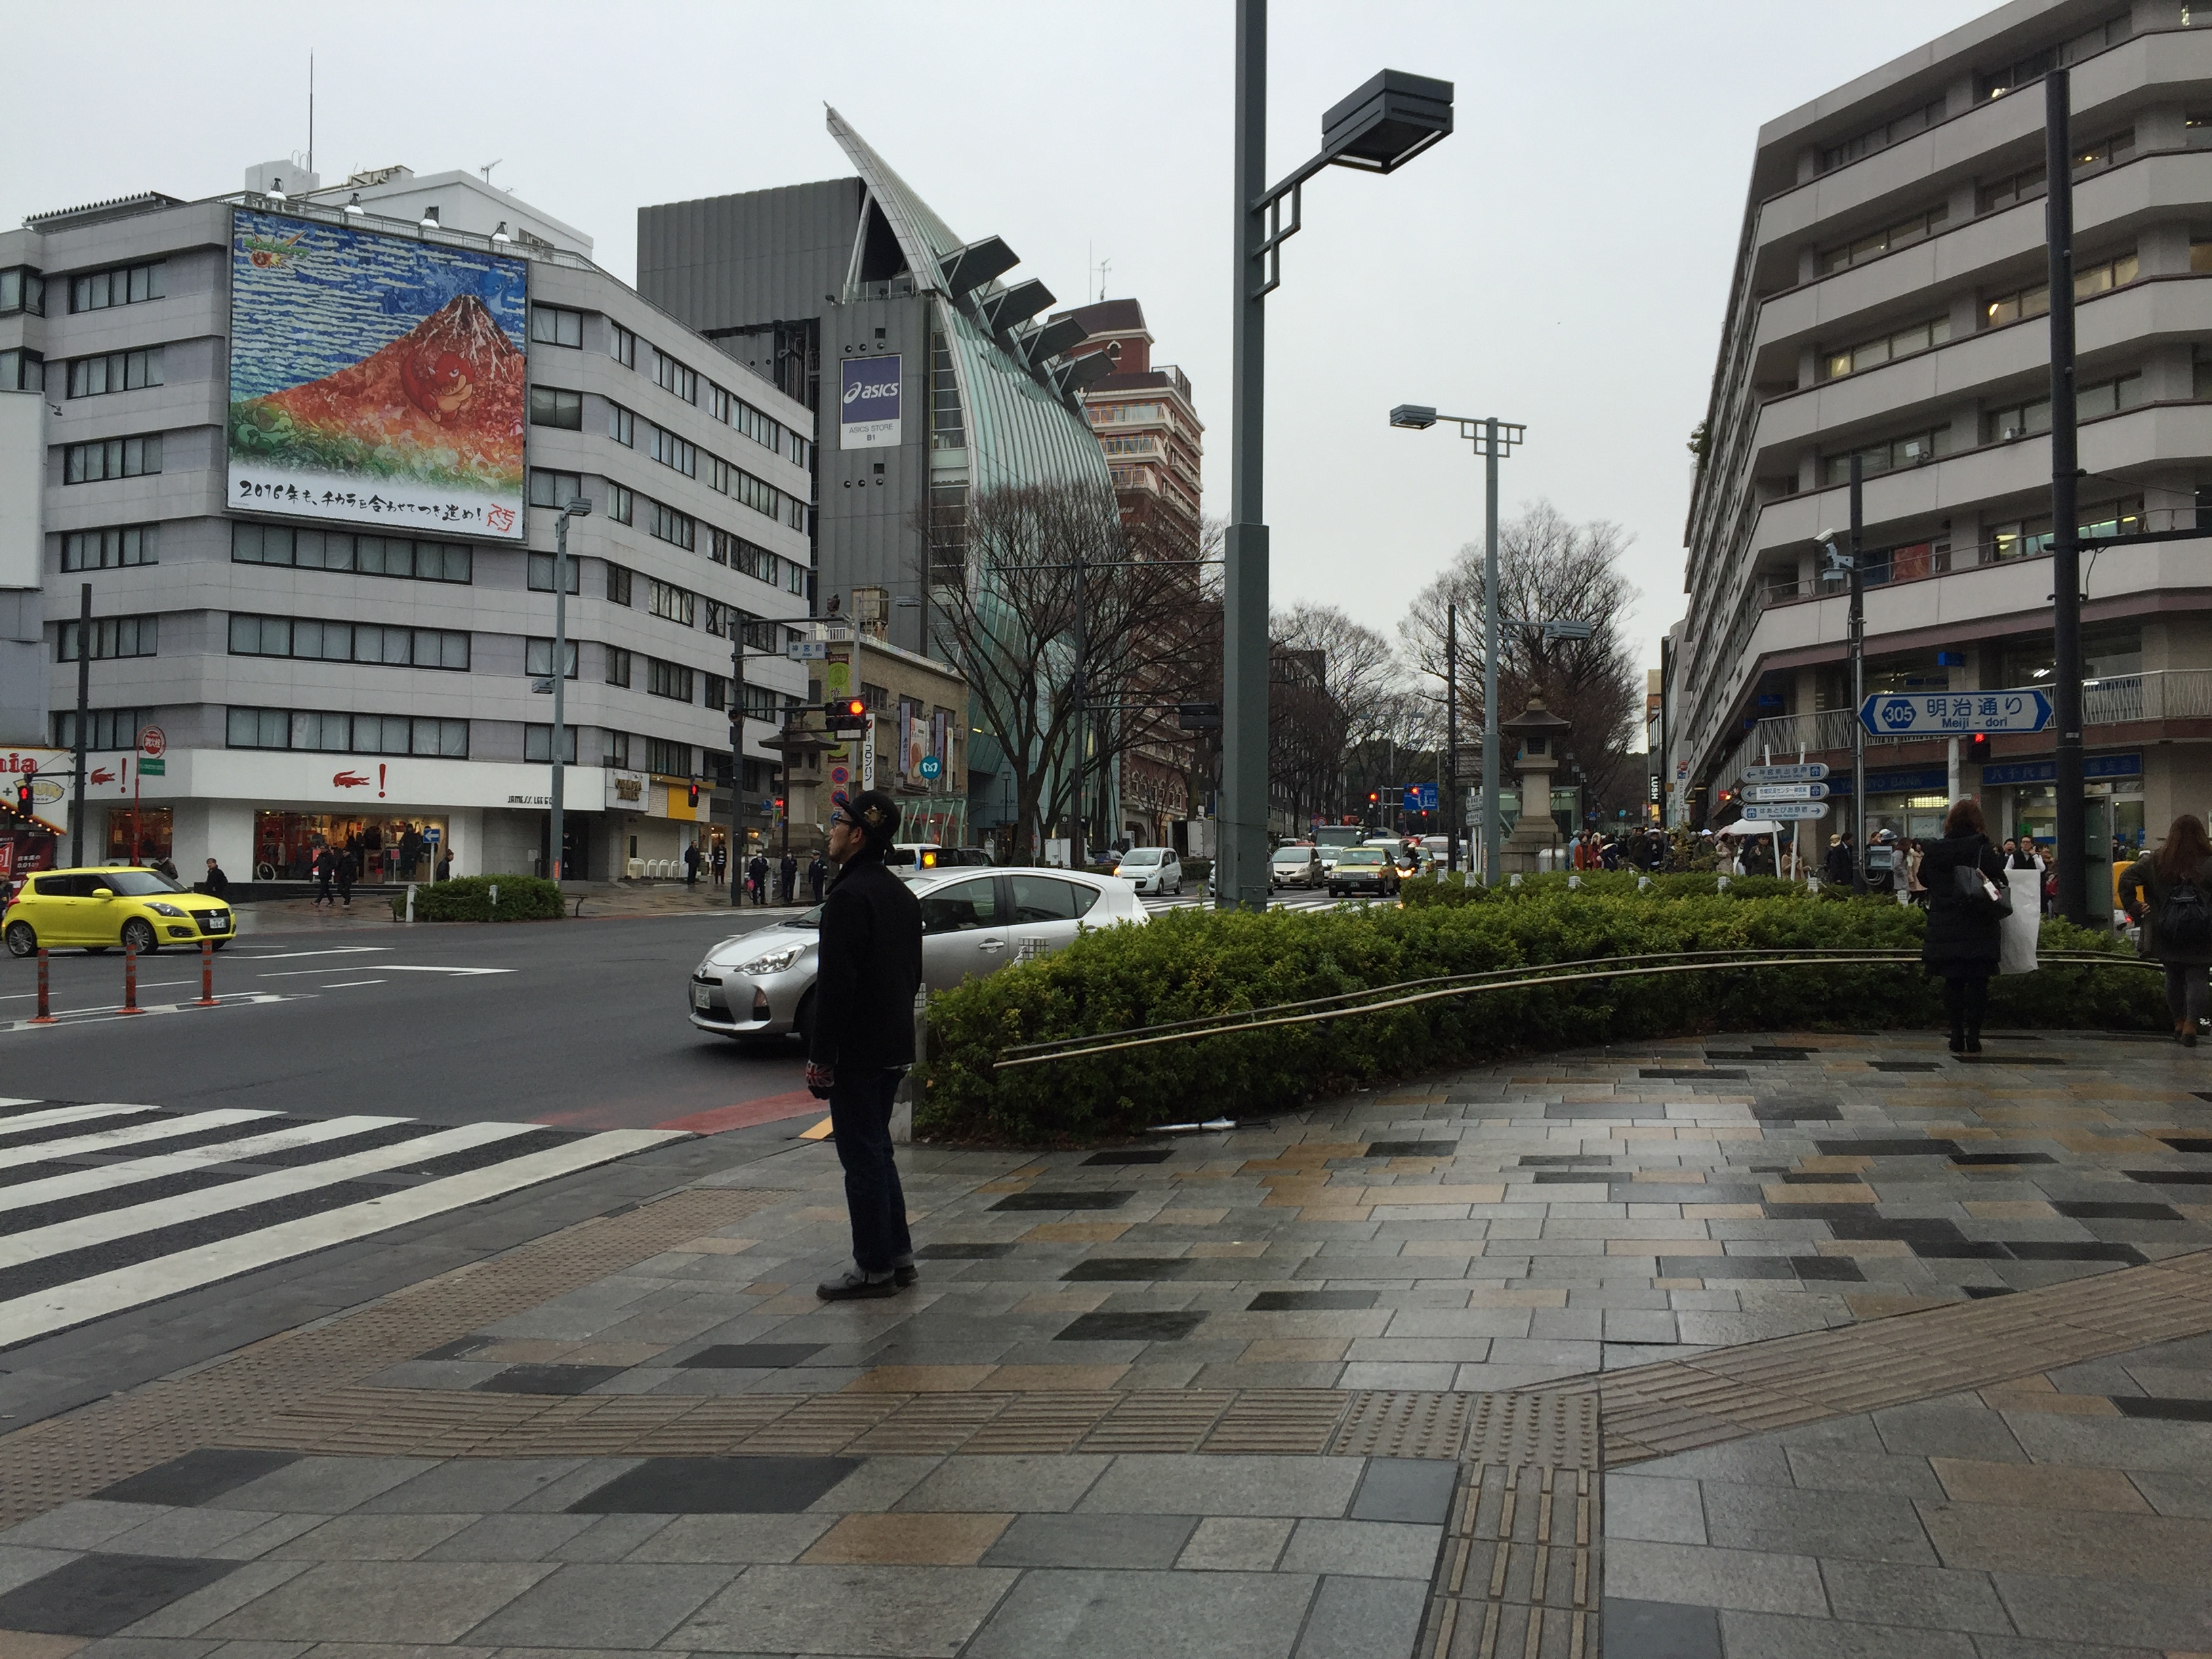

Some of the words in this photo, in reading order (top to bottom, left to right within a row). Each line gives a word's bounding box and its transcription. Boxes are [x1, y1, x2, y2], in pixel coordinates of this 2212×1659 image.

[861, 382, 899, 399] asics
[848, 424, 869, 434] ASICS
[871, 423, 893, 432] STORE
[1885, 706, 1913, 722] 305
[1927, 697, 2022, 717] 明治通り
[1942, 718, 1969, 730] Meiji
[1986, 718, 2008, 727] dori
